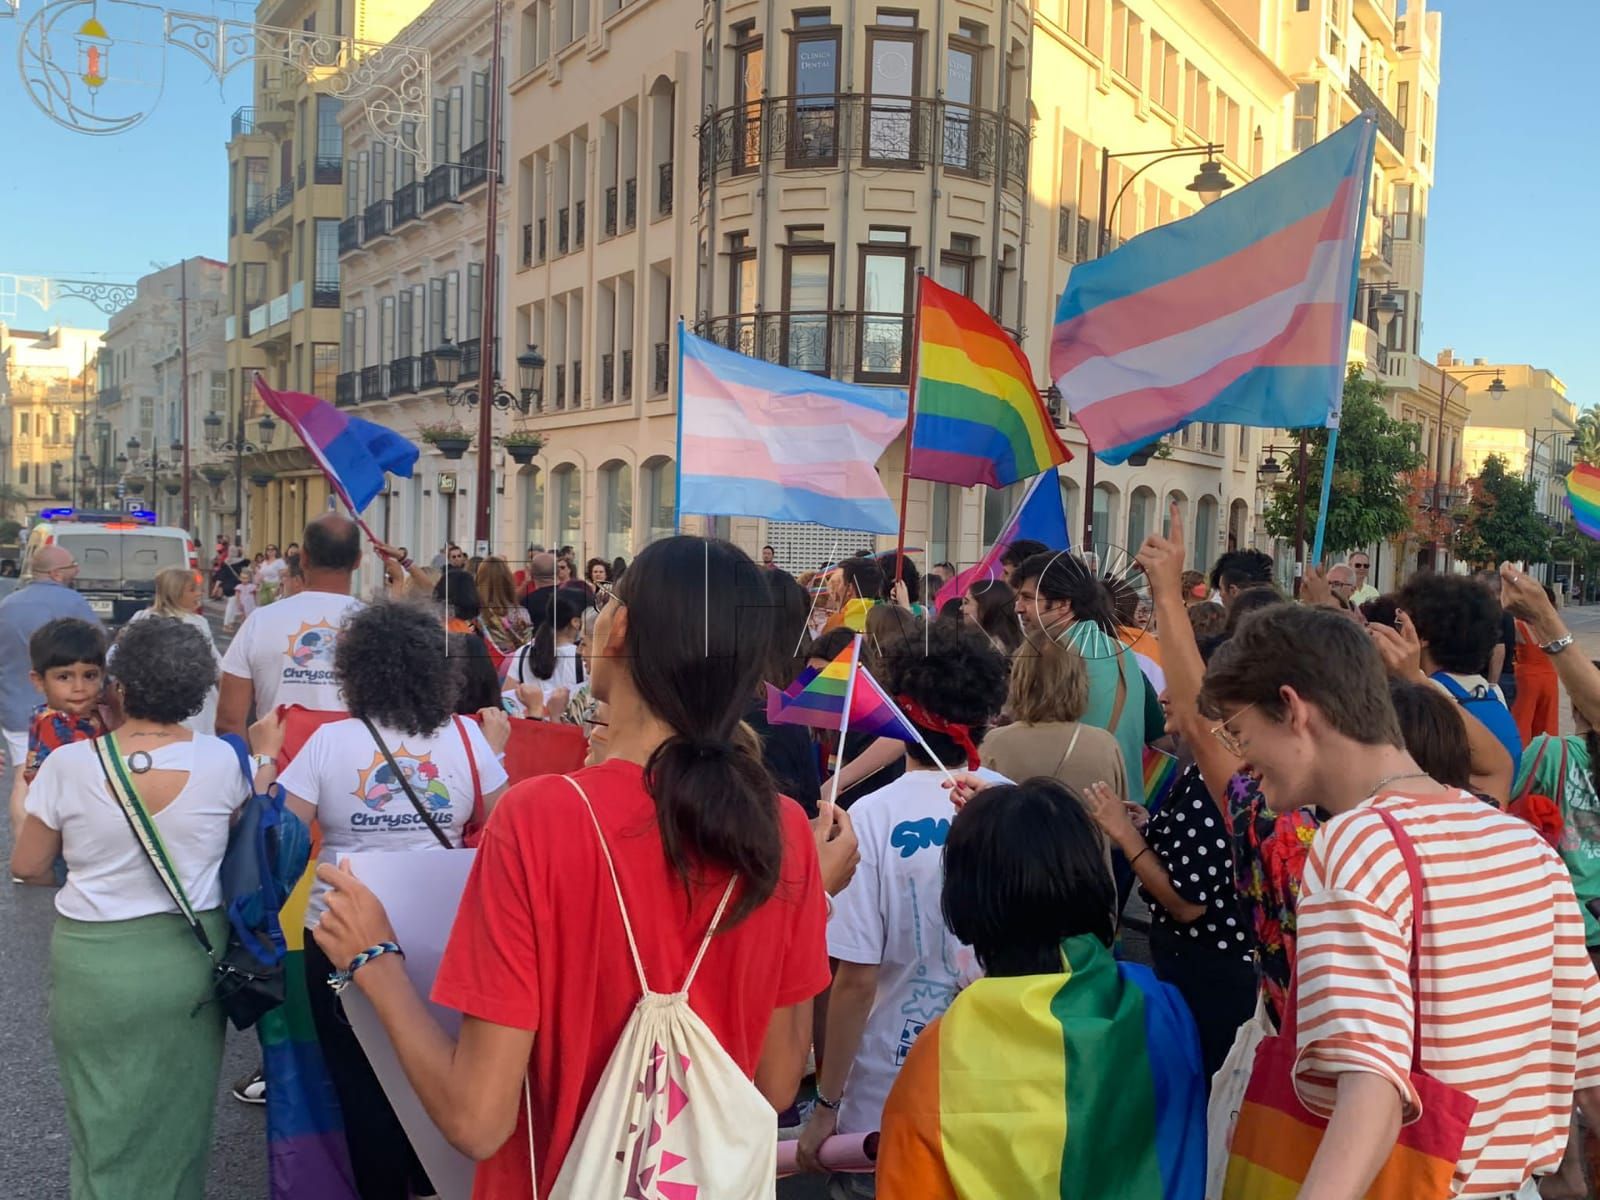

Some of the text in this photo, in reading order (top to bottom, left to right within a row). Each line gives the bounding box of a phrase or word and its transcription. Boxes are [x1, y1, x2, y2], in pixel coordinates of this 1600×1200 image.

[801, 61, 831, 70] DENTAL
[283, 668, 336, 680] Chrysa
[350, 812, 454, 827] Chrysalis
